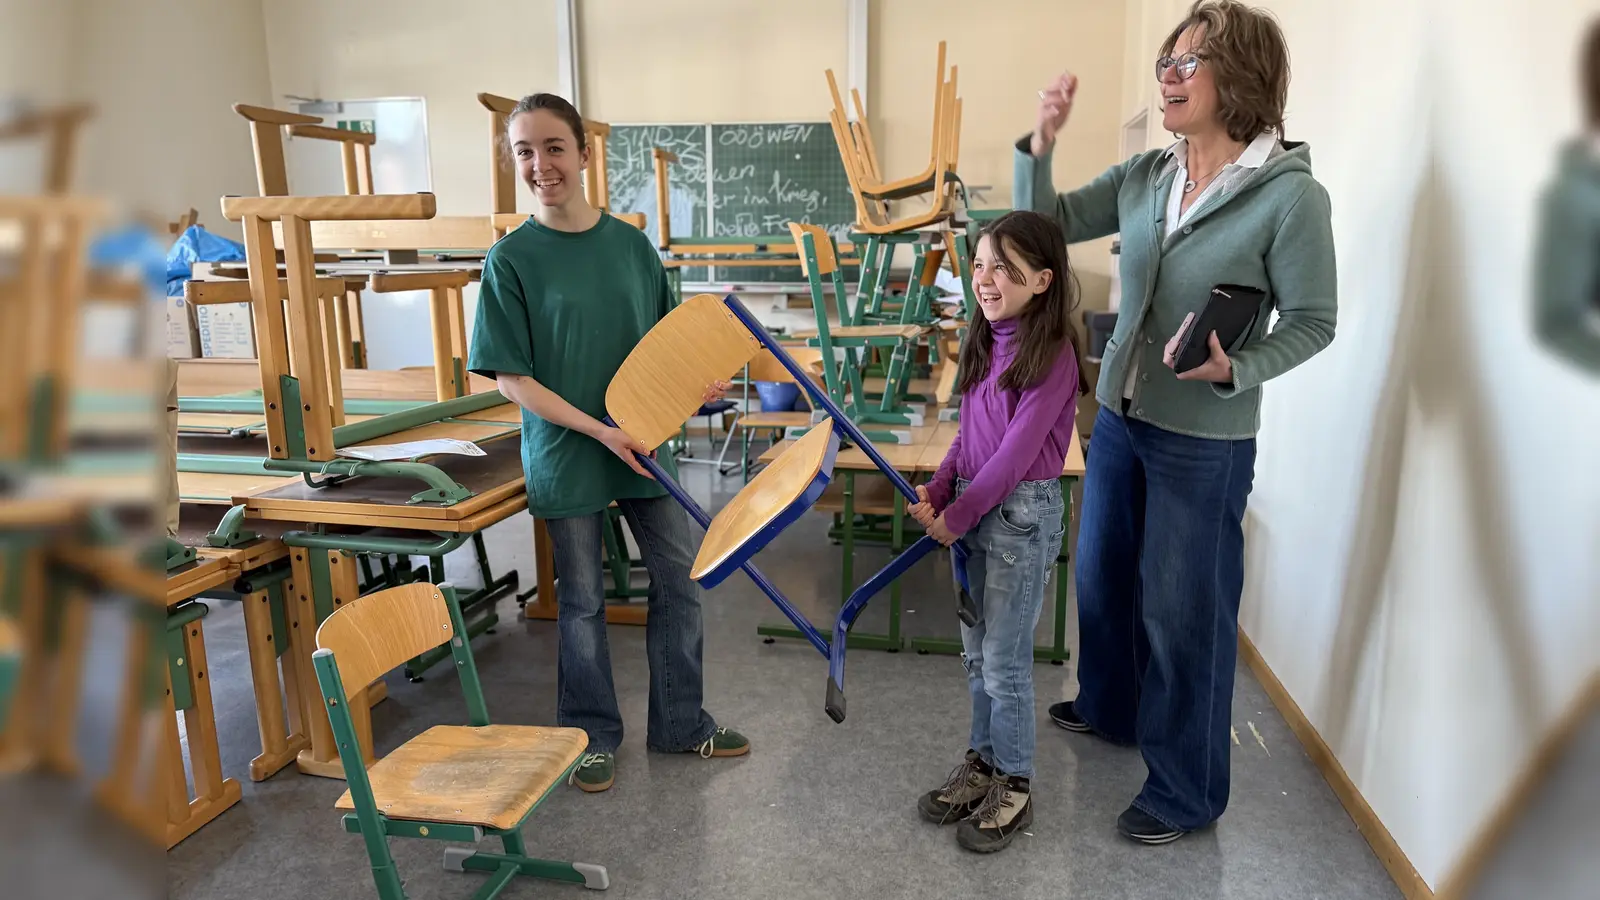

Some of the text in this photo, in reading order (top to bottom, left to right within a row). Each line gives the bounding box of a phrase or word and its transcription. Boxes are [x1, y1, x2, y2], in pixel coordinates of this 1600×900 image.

[744, 186, 770, 204] im
[769, 170, 827, 213] Krieg,
[199, 306, 213, 356] SPEDITIO
